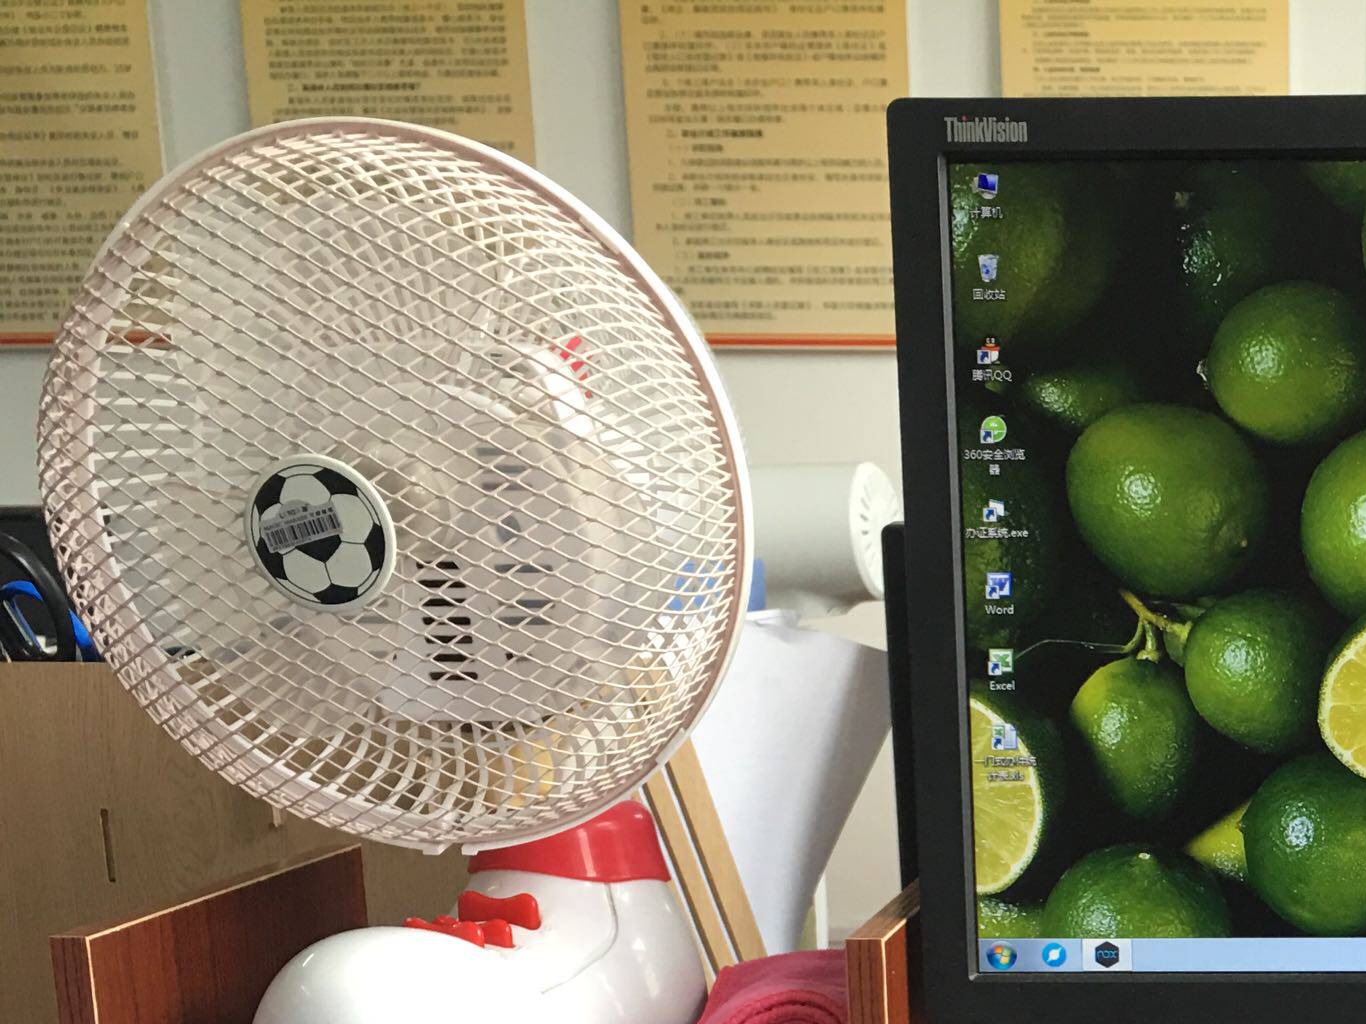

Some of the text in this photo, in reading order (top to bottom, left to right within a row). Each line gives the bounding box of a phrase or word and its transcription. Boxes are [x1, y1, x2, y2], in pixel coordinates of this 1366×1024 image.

[943, 115, 1028, 142] ThinkVision
[970, 206, 1003, 219] 计算机
[972, 288, 1006, 300] 回收站
[972, 369, 1013, 382] 腾讯QQ
[985, 604, 1015, 616] Word
[989, 680, 1016, 691] Excel
